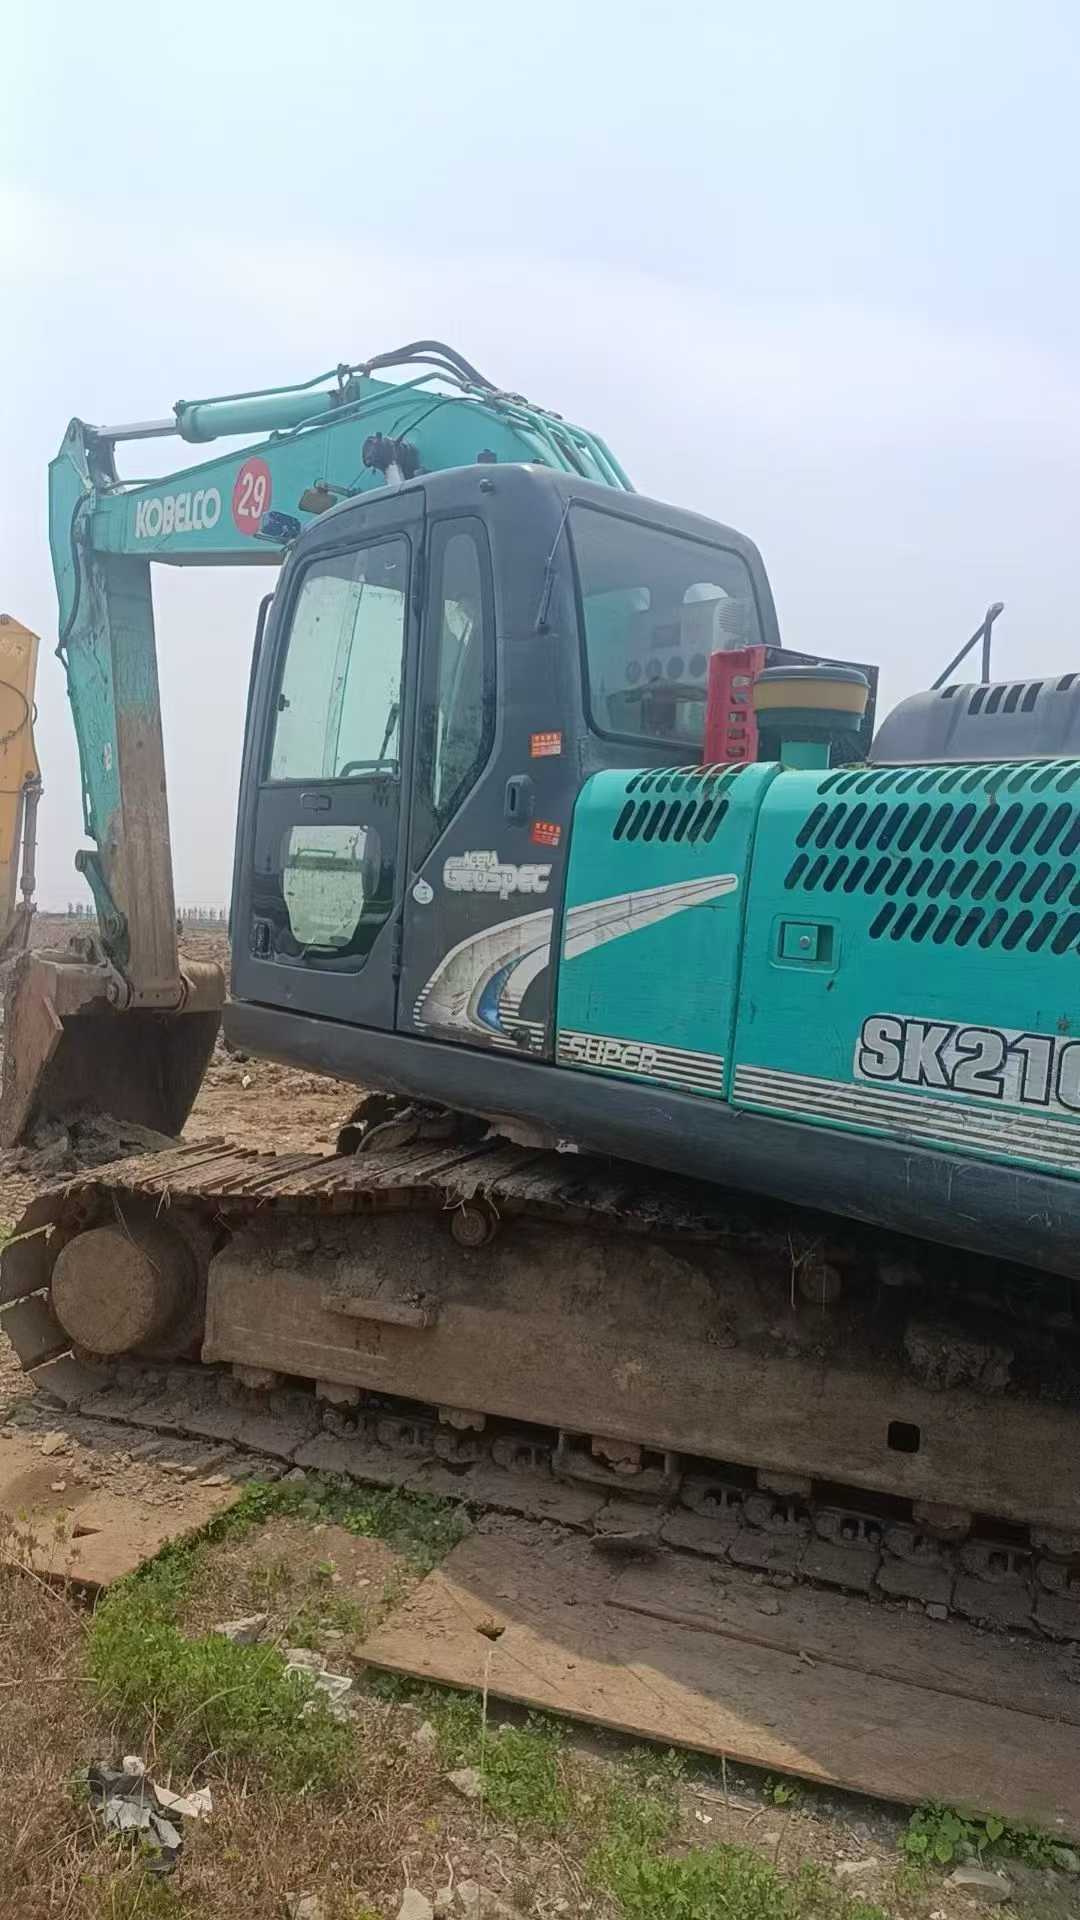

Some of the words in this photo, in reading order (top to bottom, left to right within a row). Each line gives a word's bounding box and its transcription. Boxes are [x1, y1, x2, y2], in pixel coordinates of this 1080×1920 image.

[135, 487, 222, 538] KOBELCO
[237, 473, 266, 519] 29
[569, 1037, 657, 1074] SUPER
